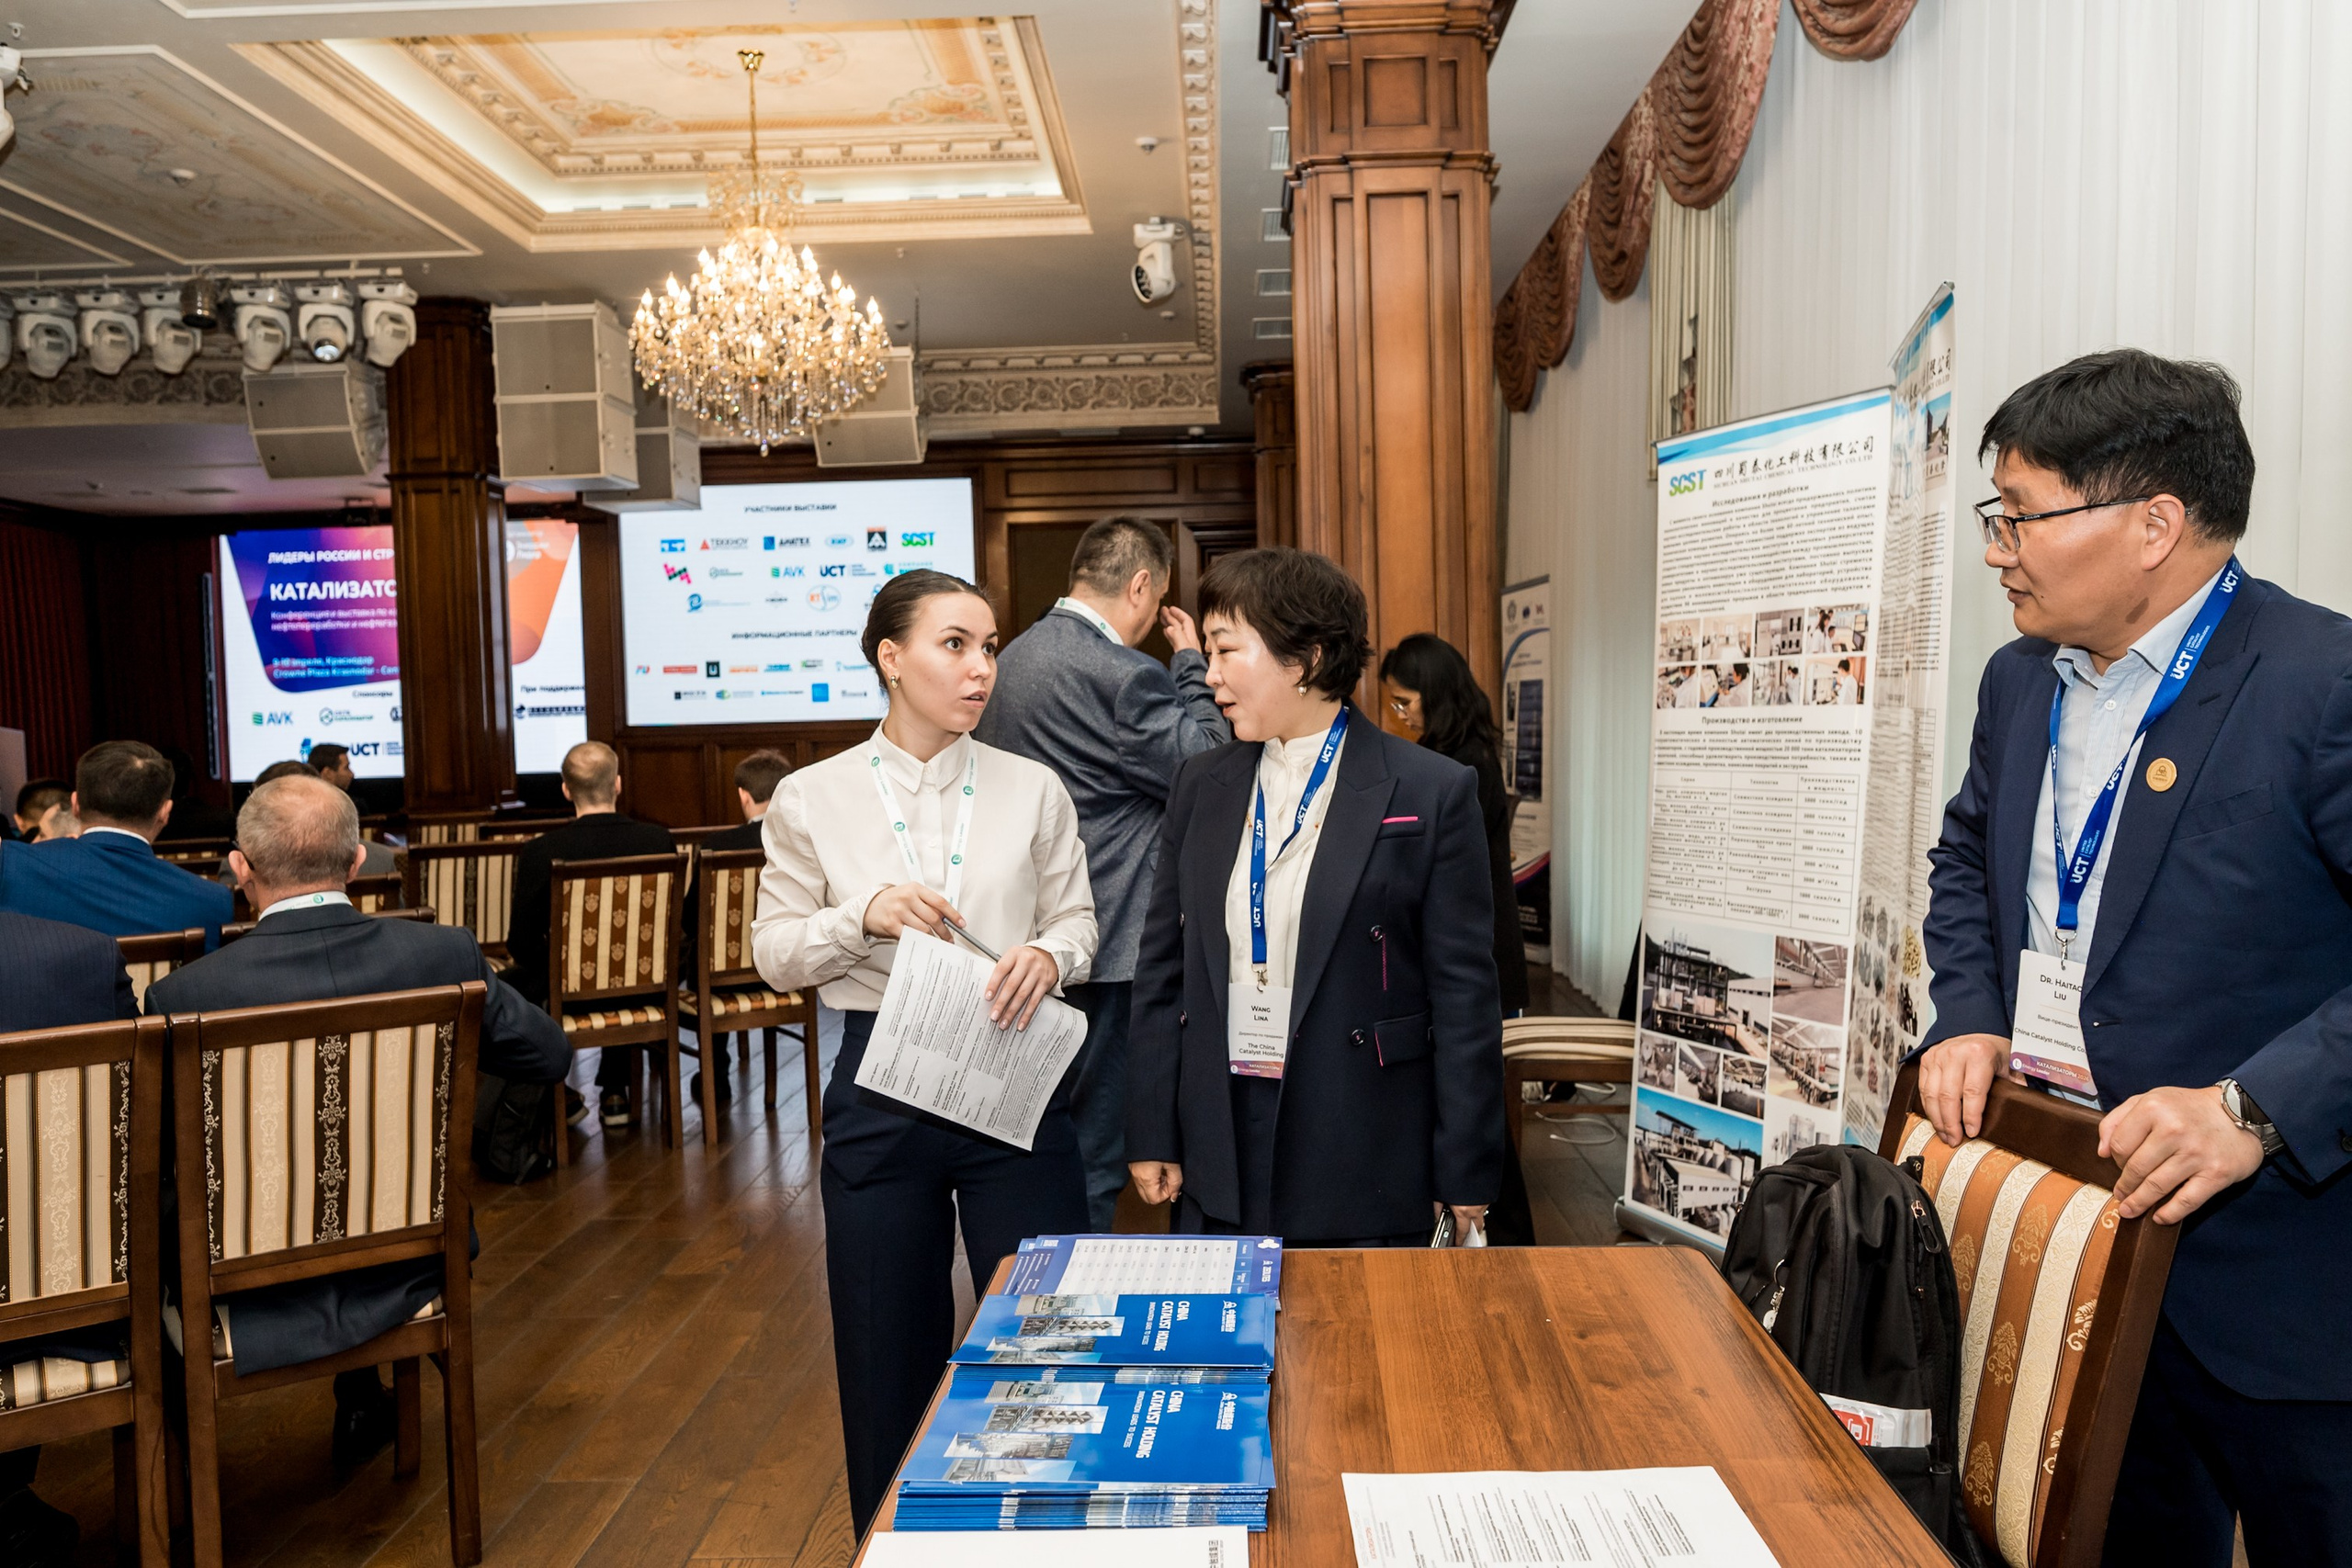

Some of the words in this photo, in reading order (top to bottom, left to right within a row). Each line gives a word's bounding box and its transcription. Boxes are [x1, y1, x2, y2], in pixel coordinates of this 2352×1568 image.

[1669, 469, 1706, 496] SCST
[1713, 494, 1760, 507] Исследования
[1769, 485, 1809, 498] разработки
[794, 503, 837, 512] ВЫСТАВКИ
[901, 532, 935, 547] SCST
[268, 550, 314, 564] ЛИДЕРЫ
[317, 549, 361, 562] РОССИИ
[363, 550, 372, 560] И
[783, 566, 805, 577] AVK
[820, 565, 846, 577] UCT
[2219, 570, 2239, 593] UCT
[731, 630, 812, 640] ИНФОРМАЦИОННЫЕ
[325, 656, 374, 666] Краснодар
[2170, 650, 2193, 681] UCT
[274, 667, 305, 678] Crowne
[307, 667, 330, 677] Plaza
[332, 666, 375, 676] Krasnodar
[352, 690, 393, 698] Спонсоры
[520, 684, 537, 693] При
[266, 712, 293, 725] AVK
[1702, 716, 1749, 725] Производство
[351, 742, 379, 756] UCT
[1320, 743, 1334, 763] UCT
[2106, 762, 2124, 792] UCT
[1296, 804, 1308, 825] UCT
[2069, 856, 2090, 886] UCT
[1253, 906, 1261, 928] UCT
[2038, 1014, 2078, 1030] Вице-президент
[2015, 1028, 2030, 1036] China
[2031, 1032, 2052, 1043] Catalyst
[2054, 1040, 2075, 1051] Holding
[2036, 1061, 2076, 1077] КАТАЛИЗАТОРЫ
[1159, 1301, 1173, 1329] CATALYST
[1177, 1301, 1190, 1321] CHINA
[1153, 1331, 1170, 1351] HOLDING
[1146, 1390, 1166, 1425] CATALYST
[1166, 1391, 1184, 1414] CHINA
[1136, 1427, 1158, 1459] HOLDING
